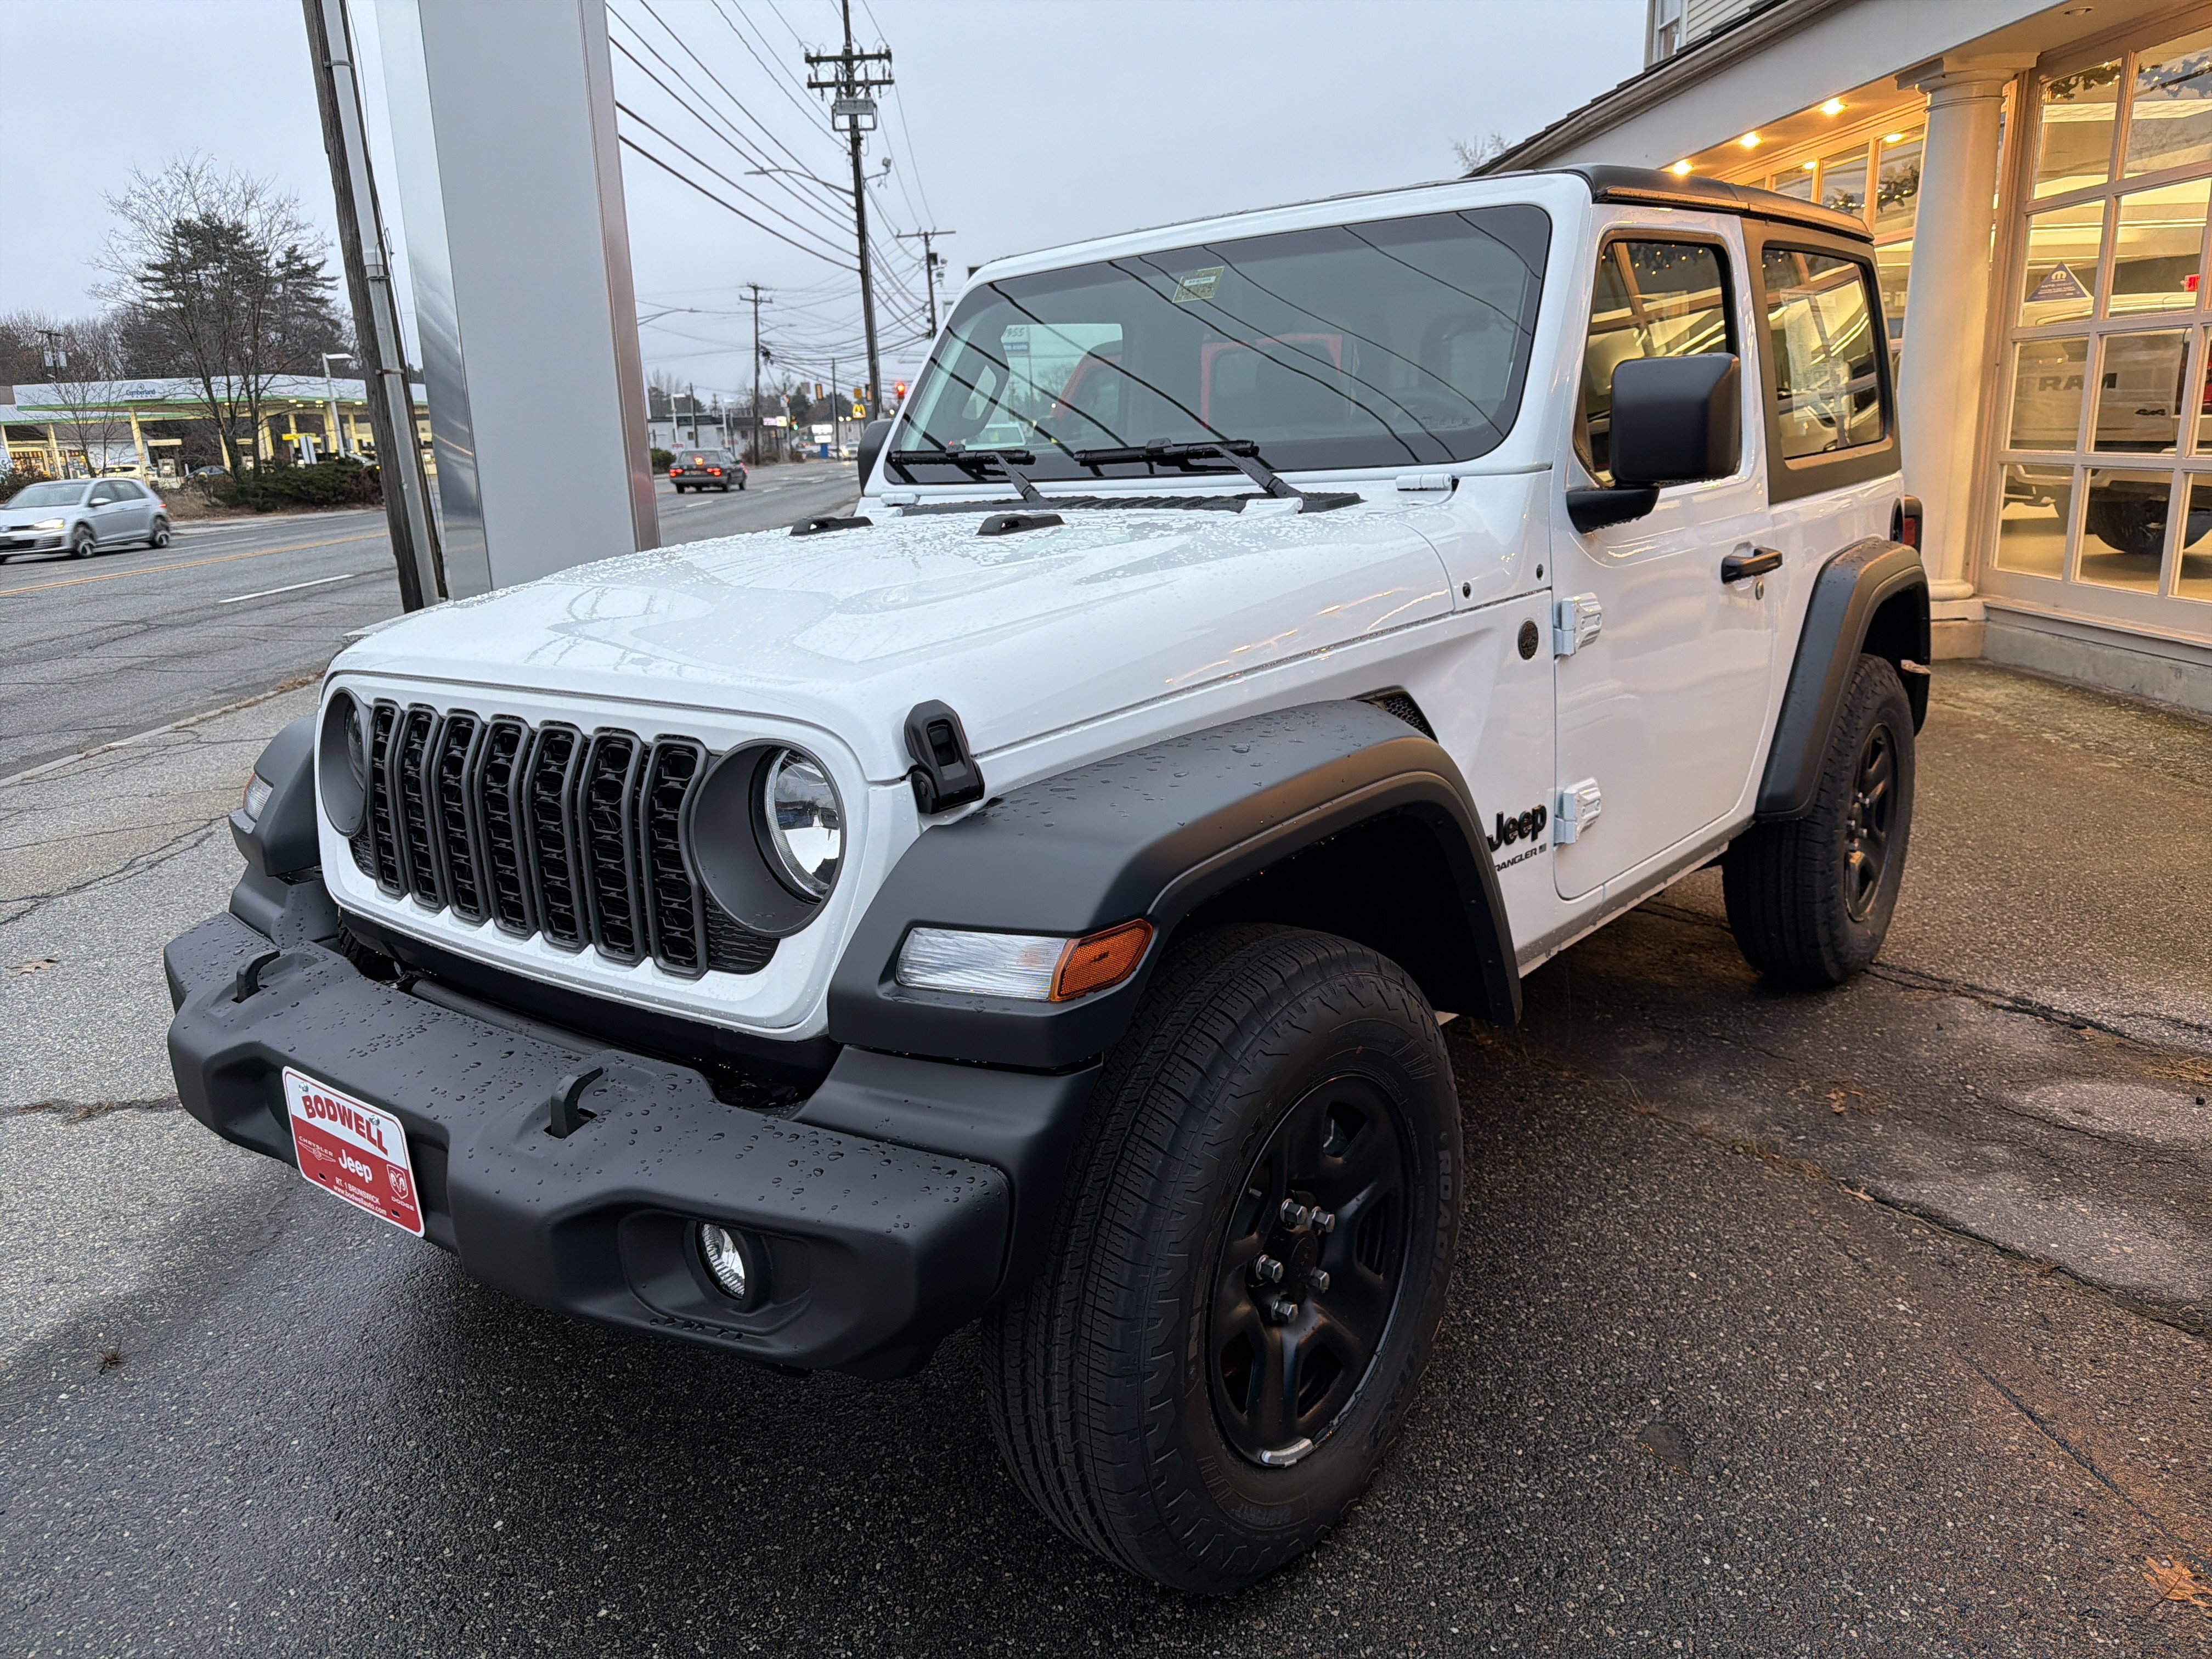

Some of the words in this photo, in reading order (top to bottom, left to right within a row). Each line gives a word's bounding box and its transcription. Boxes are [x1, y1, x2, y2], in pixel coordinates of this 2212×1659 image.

[2039, 373, 2118, 391] RAM
[1486, 804, 1547, 852] Jeep
[1494, 847, 1538, 872] RANGLER
[302, 1094, 388, 1156] BODWELL
[298, 1136, 334, 1156] CHRYSLER
[338, 1149, 373, 1183] Jeep
[333, 1185, 387, 1216] www.bodwellauto.com
[348, 1183, 381, 1205] BRUNSWICK
[391, 1196, 415, 1211] DODGE
